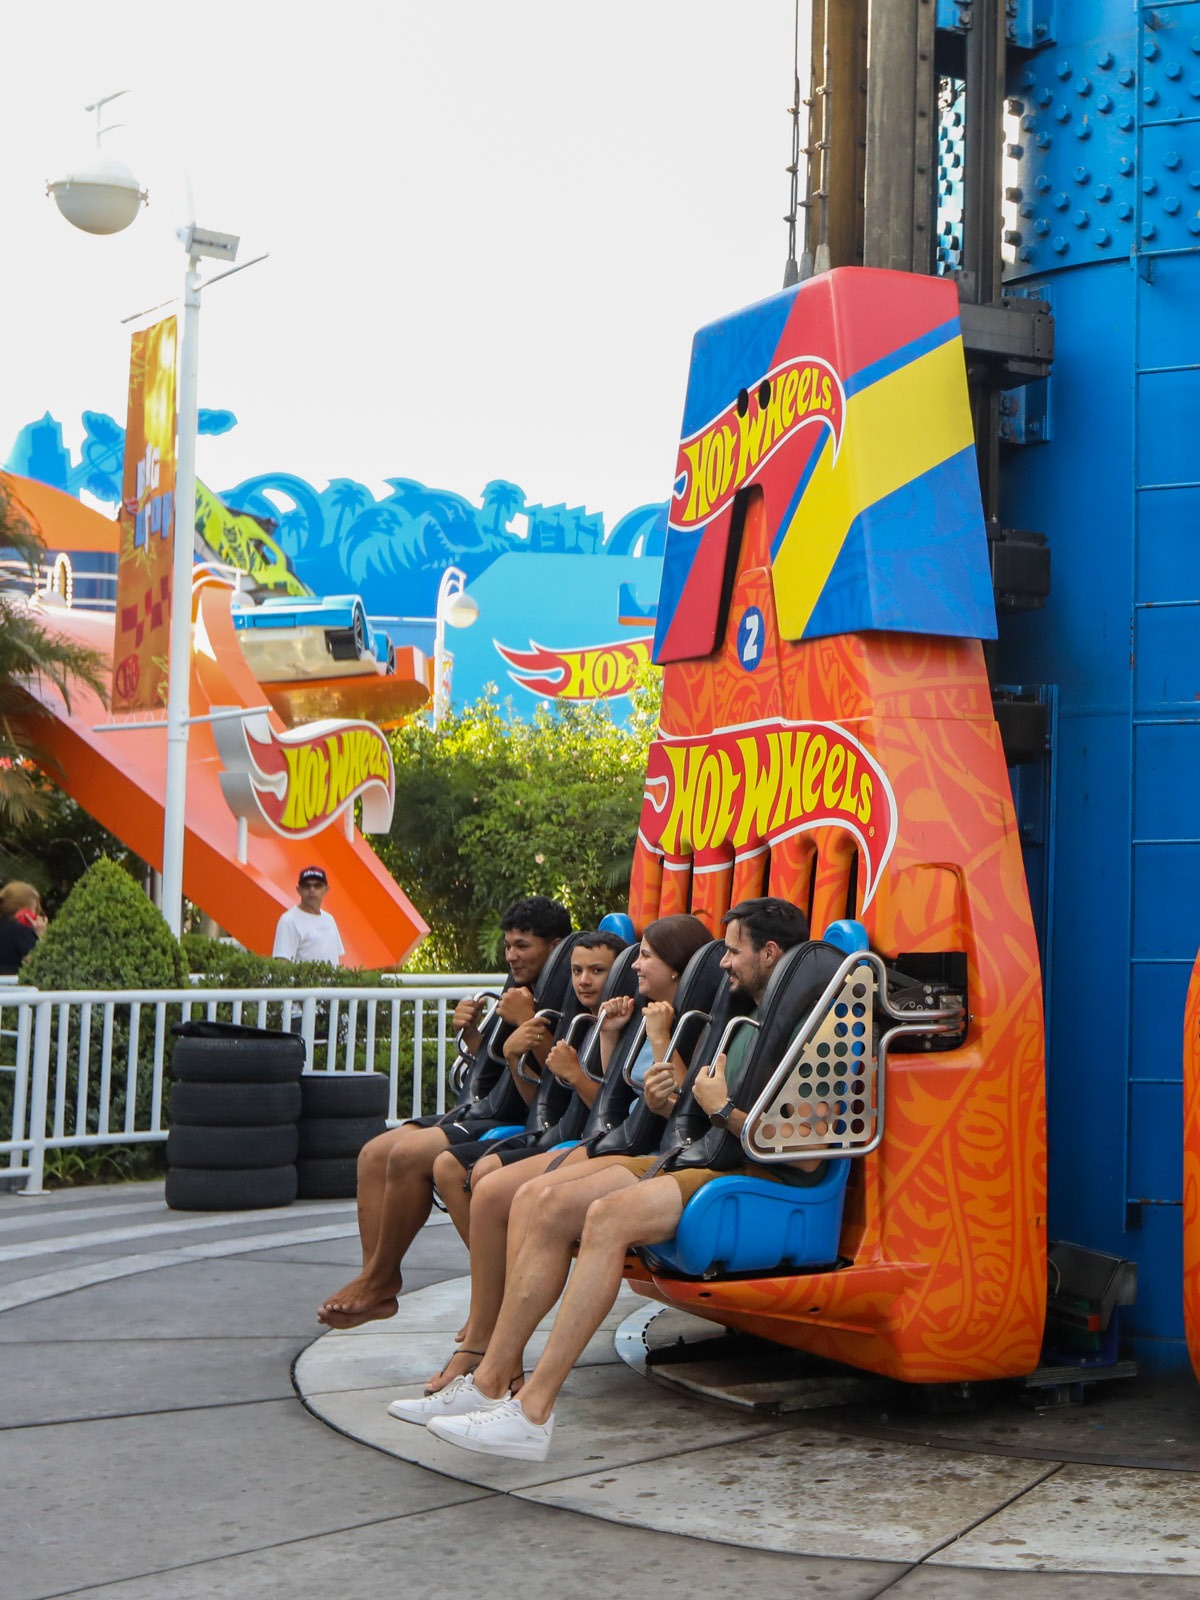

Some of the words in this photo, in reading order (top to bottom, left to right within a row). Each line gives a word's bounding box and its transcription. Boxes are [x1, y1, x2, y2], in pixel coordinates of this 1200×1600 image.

[681, 424, 738, 521] HOT
[742, 614, 760, 662] 2
[279, 744, 330, 830] HOT
[658, 744, 742, 856] HOT
